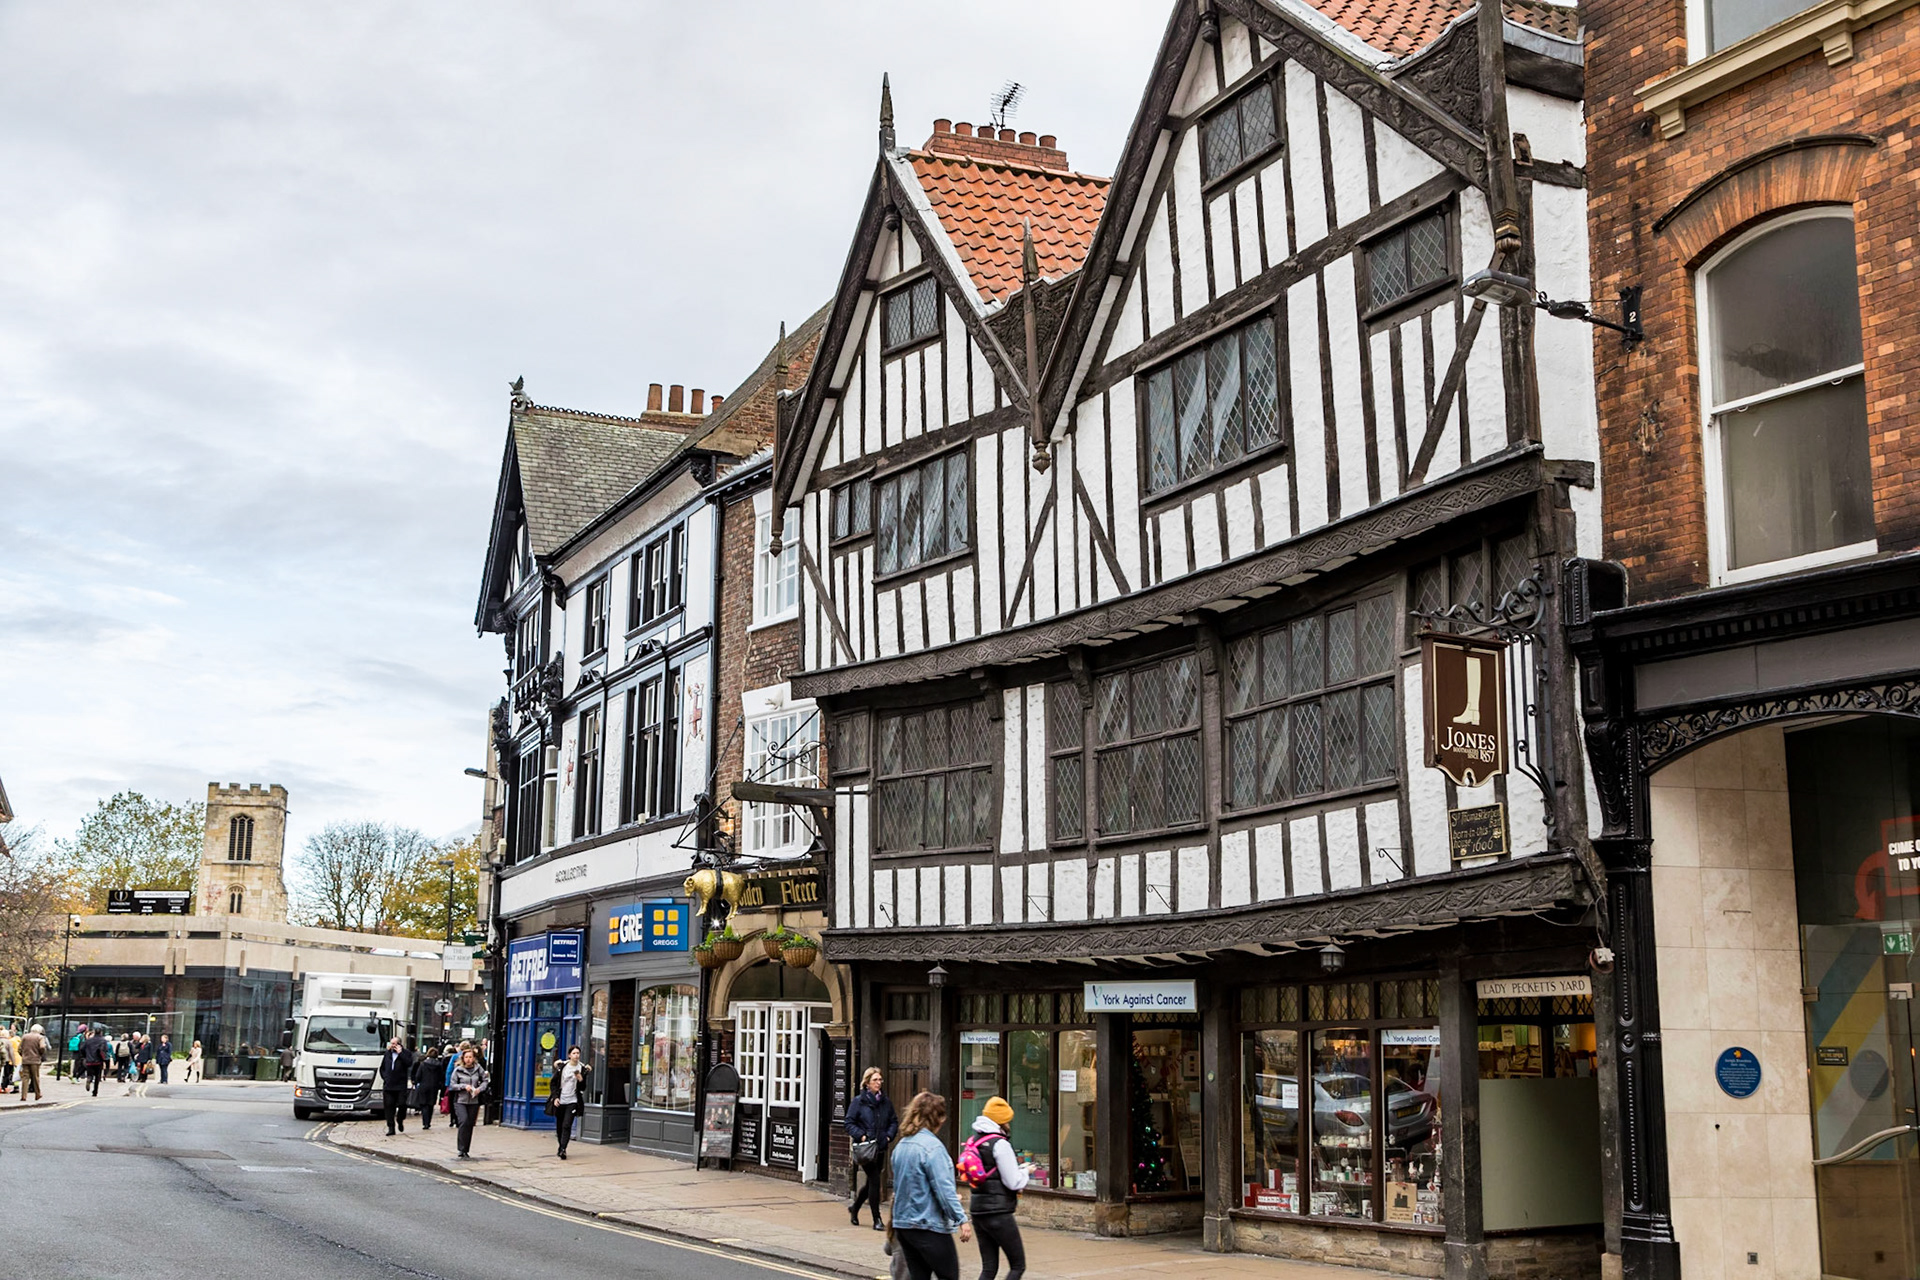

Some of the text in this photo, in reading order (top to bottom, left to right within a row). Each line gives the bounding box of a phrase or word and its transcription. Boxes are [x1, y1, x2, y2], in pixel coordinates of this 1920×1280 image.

[1441, 727, 1495, 750] JONES
[1480, 750, 1495, 762] 1857
[1472, 837, 1494, 853] 1606
[1888, 841, 1914, 855] COME
[1898, 858, 1910, 871] TO
[780, 880, 818, 904] Fleece
[620, 913, 642, 943] GRE
[1483, 984, 1506, 994] LADY
[1562, 980, 1585, 991] YARD
[1103, 993, 1187, 1008] York Against Cancer
[976, 1035, 989, 1043] Against
[1393, 1035, 1440, 1045] York Against Can
[774, 1124, 793, 1135] The York
[773, 1134, 795, 1146] Terror Trail
